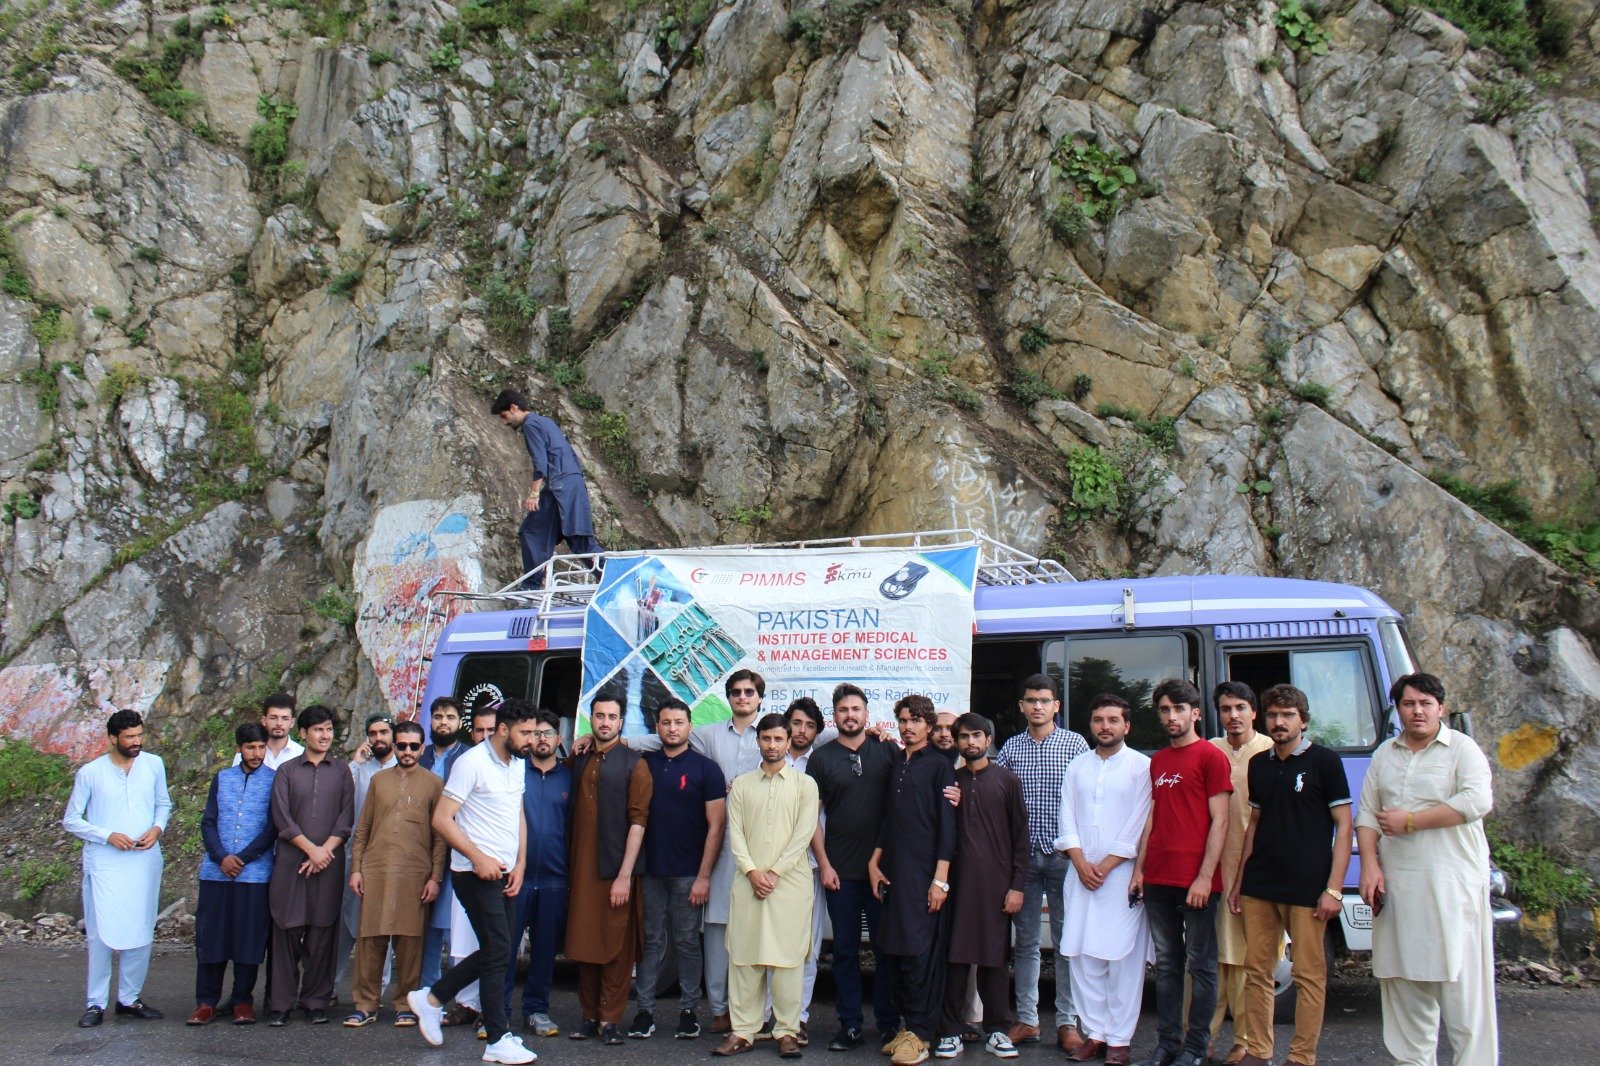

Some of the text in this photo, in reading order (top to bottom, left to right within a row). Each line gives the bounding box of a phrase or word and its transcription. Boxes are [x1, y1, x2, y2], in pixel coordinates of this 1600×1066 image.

[739, 571, 806, 586] PIMMS
[837, 570, 872, 581] kmu
[757, 608, 879, 630] PAKISTAN
[757, 632, 918, 645] INSTITUTE OF MEDICAL
[757, 648, 947, 662] & MANAGEMENT SCIENCES
[756, 665, 792, 673] Committed
[876, 664, 922, 672] Management
[771, 689, 788, 701] BS
[864, 688, 880, 700] BS
[770, 704, 786, 714] BS
